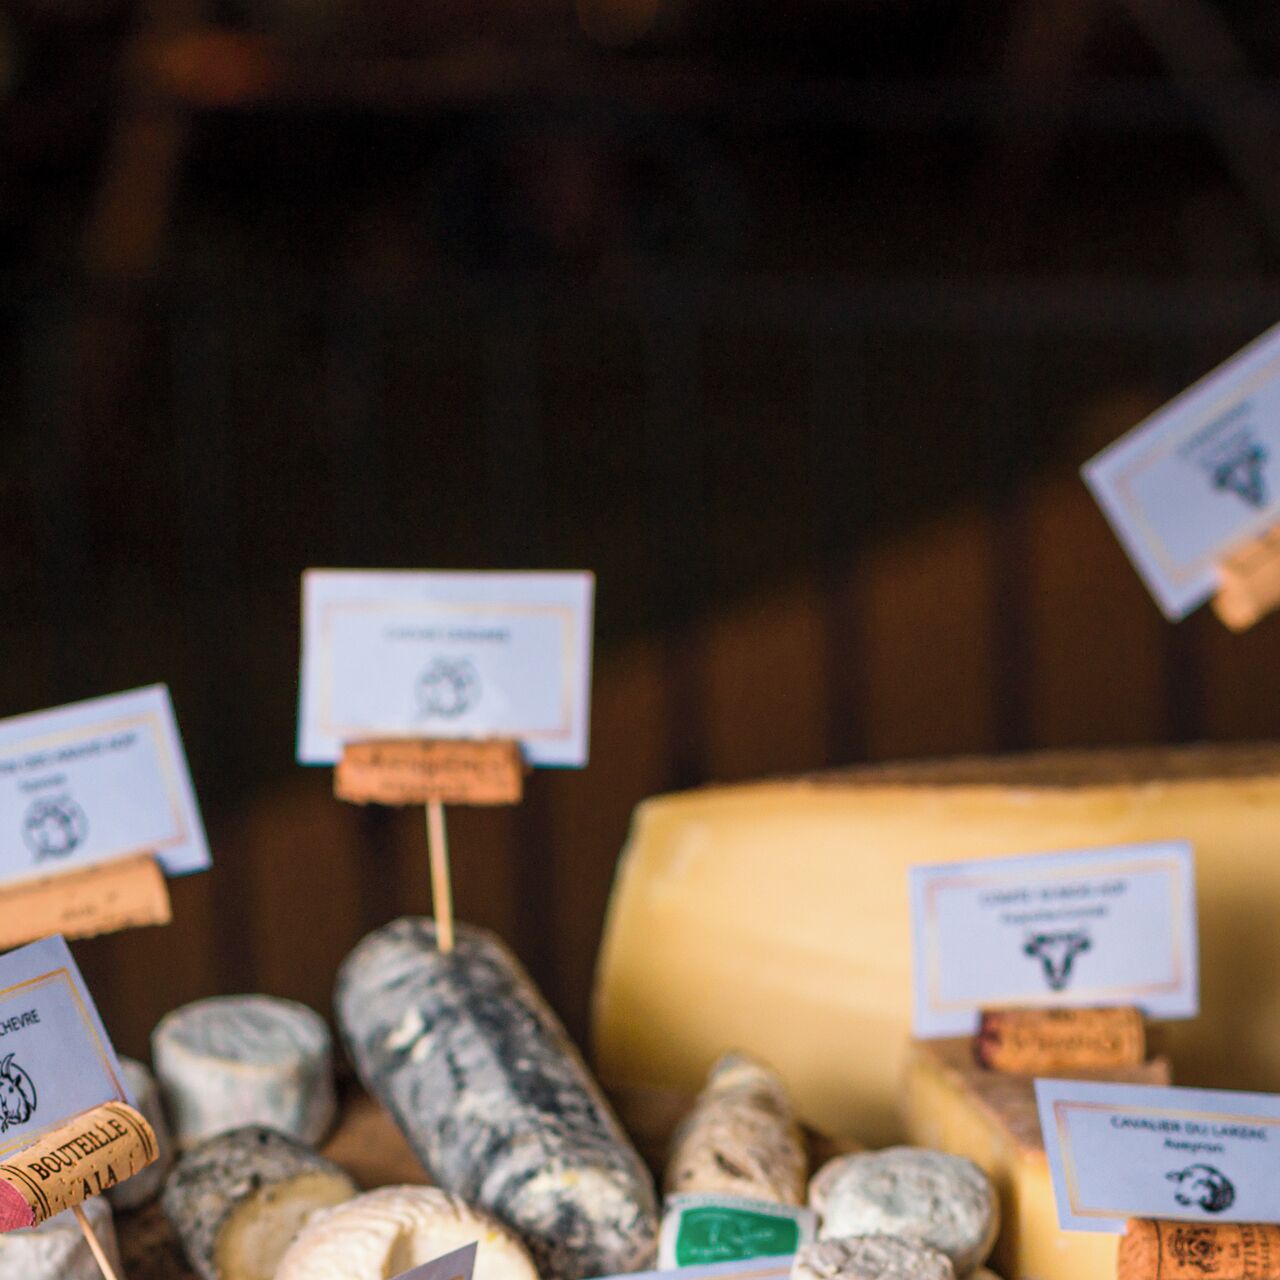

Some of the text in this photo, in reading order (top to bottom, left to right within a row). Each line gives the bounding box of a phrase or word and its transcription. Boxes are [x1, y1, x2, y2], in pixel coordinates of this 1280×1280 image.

[28, 1119, 128, 1180] BOUTEILLE
[1110, 1115, 1268, 1142] CAVALIER DU LARZAC
